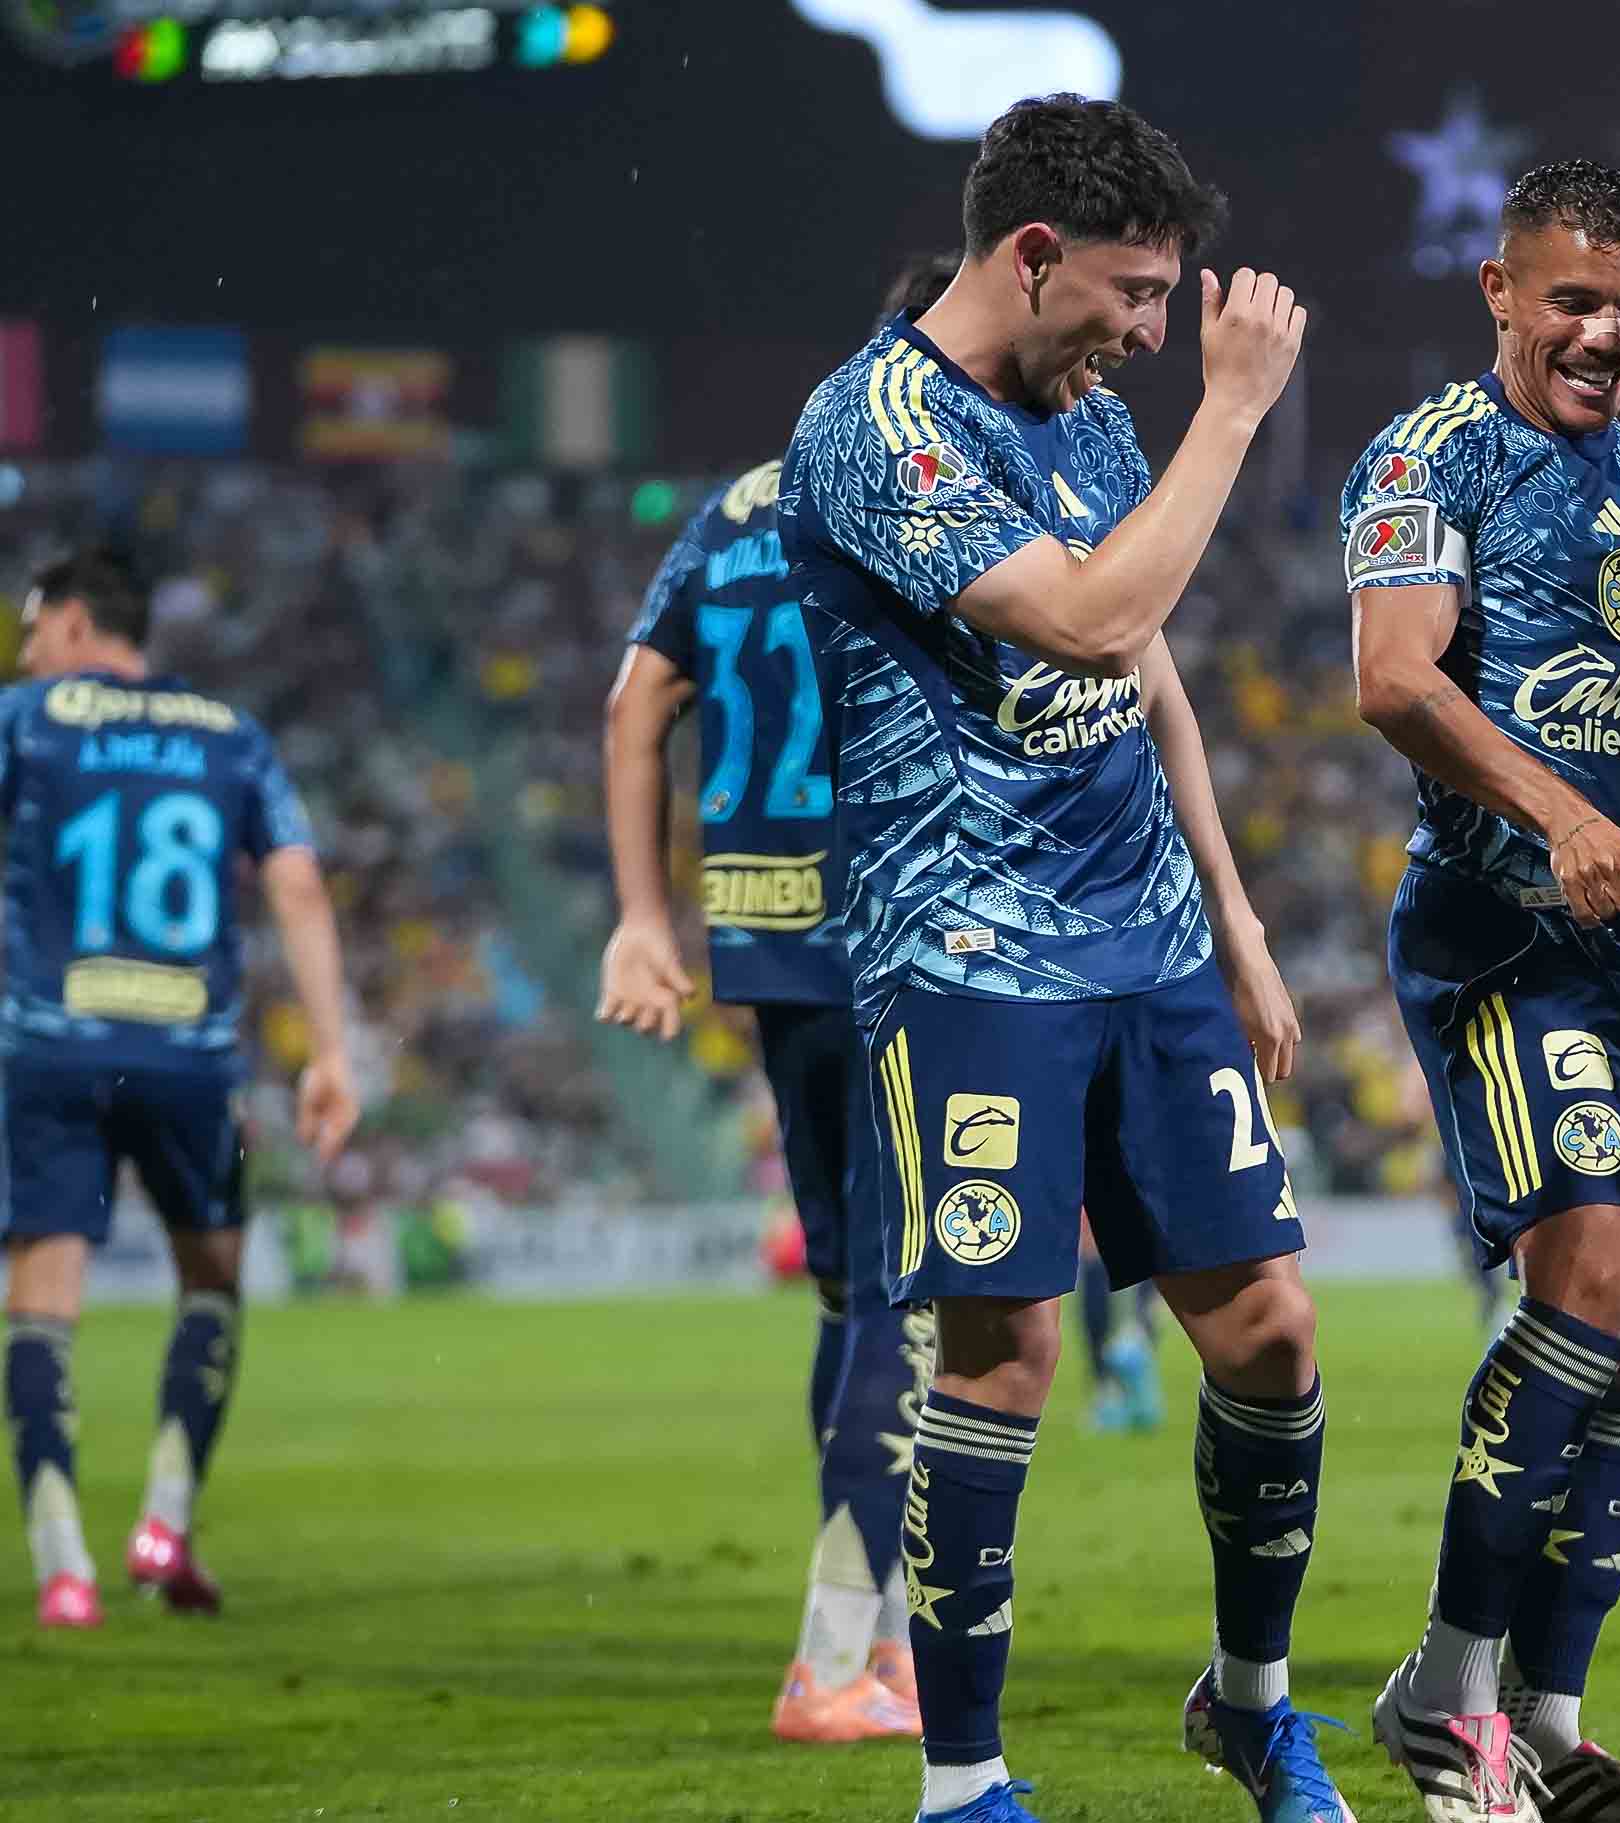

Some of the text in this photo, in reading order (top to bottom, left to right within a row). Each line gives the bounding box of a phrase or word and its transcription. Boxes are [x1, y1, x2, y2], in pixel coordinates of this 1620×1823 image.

[697, 600, 834, 825] 32
[56, 789, 225, 953] 18
[703, 867, 823, 914] BIMBO
[1259, 1479, 1310, 1499] CA
